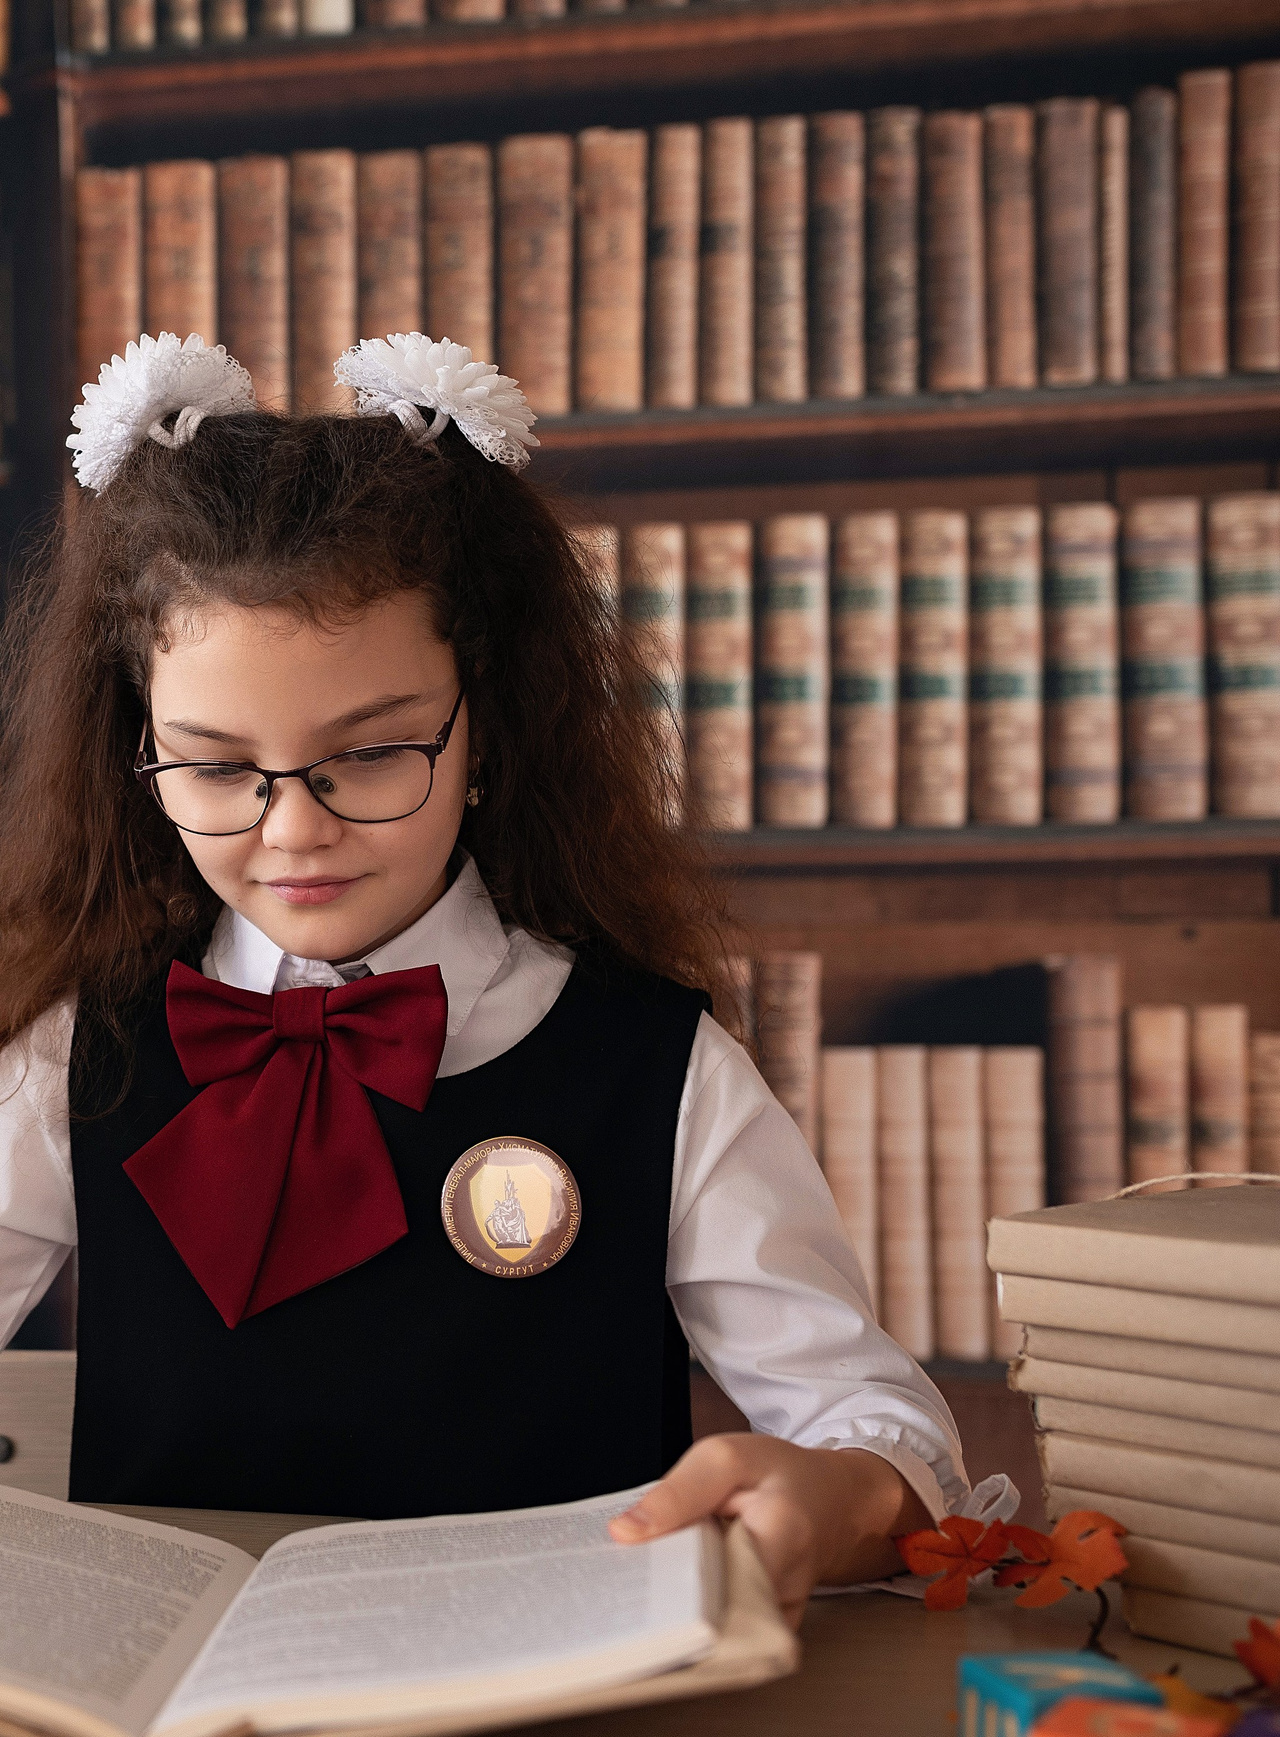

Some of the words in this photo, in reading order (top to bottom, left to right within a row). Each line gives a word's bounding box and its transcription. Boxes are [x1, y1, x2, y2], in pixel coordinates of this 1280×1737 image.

[444, 1145, 498, 1204] ГЕНЕРАЛ-МАЙОРА
[556, 1168, 579, 1211] ВАСИЛИЯ
[444, 1204, 458, 1236] ИМЕНИ
[549, 1211, 580, 1262] ИВАНОВИЧА
[494, 1264, 534, 1276] СУРГУТ
